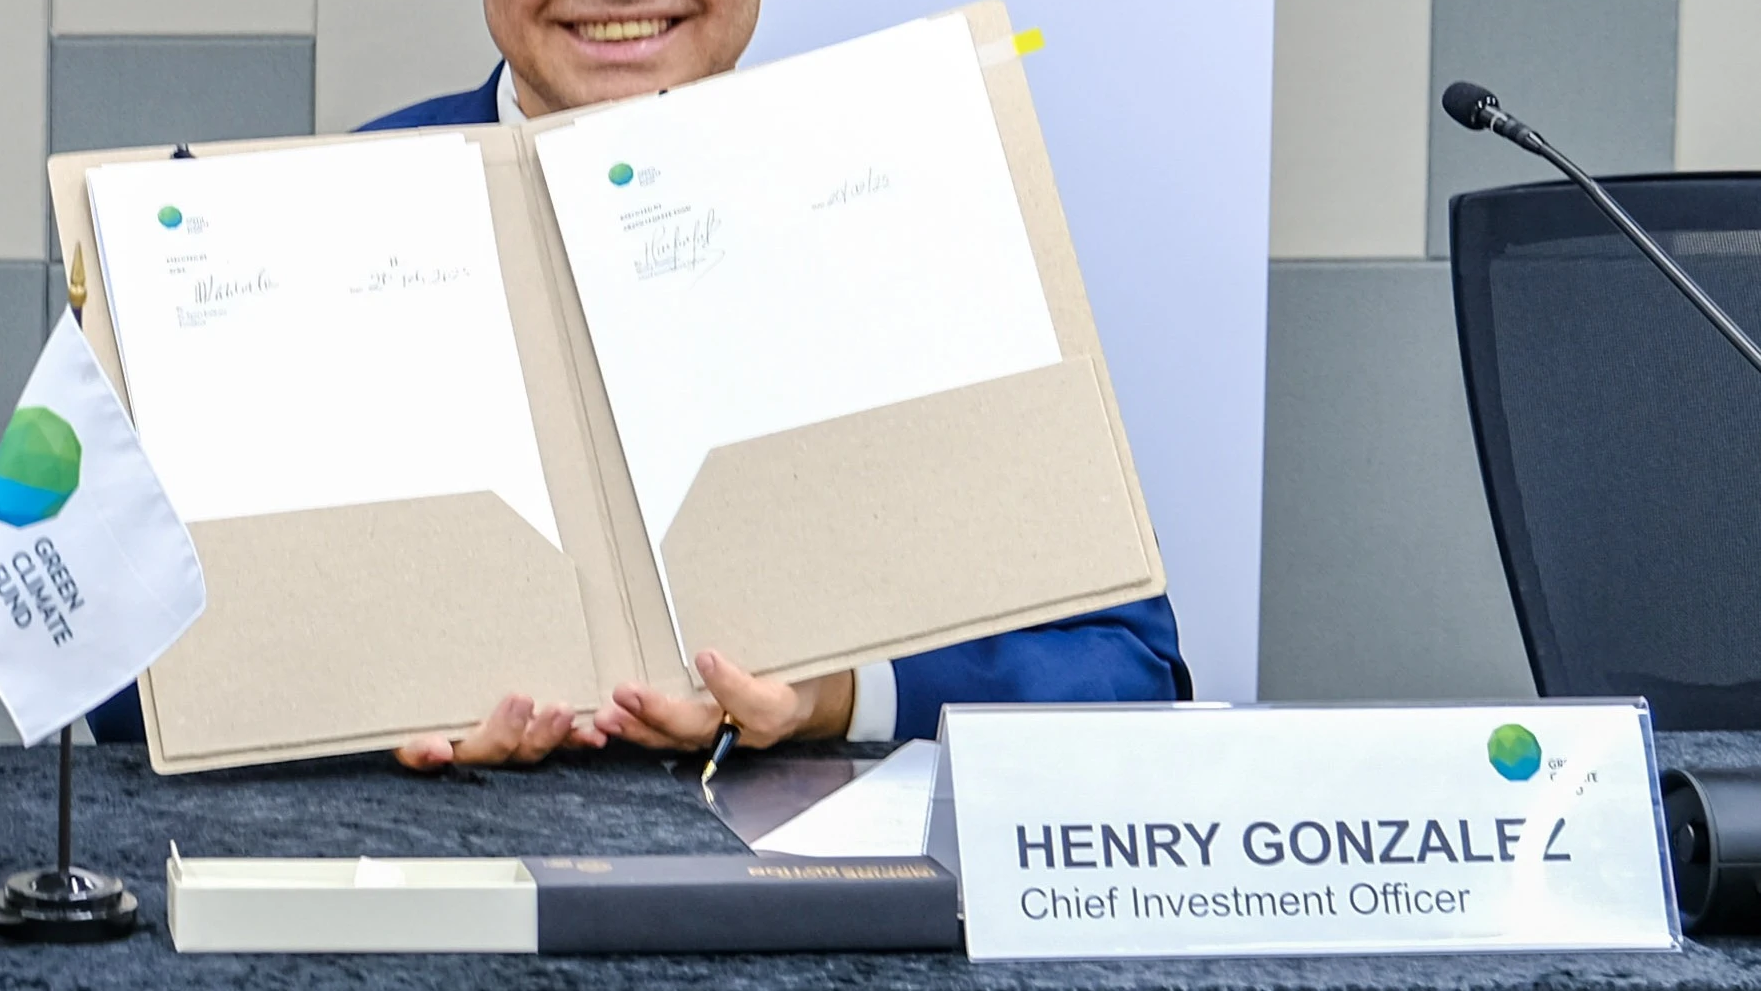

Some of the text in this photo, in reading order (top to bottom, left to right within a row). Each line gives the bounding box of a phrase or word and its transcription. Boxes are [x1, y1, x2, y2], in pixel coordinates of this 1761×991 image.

[12, 551, 74, 647] CLIMATE
[35, 536, 85, 613] GREEN
[1016, 821, 1222, 870] HENRY
[1020, 881, 1472, 920] Chief Investment Officer
